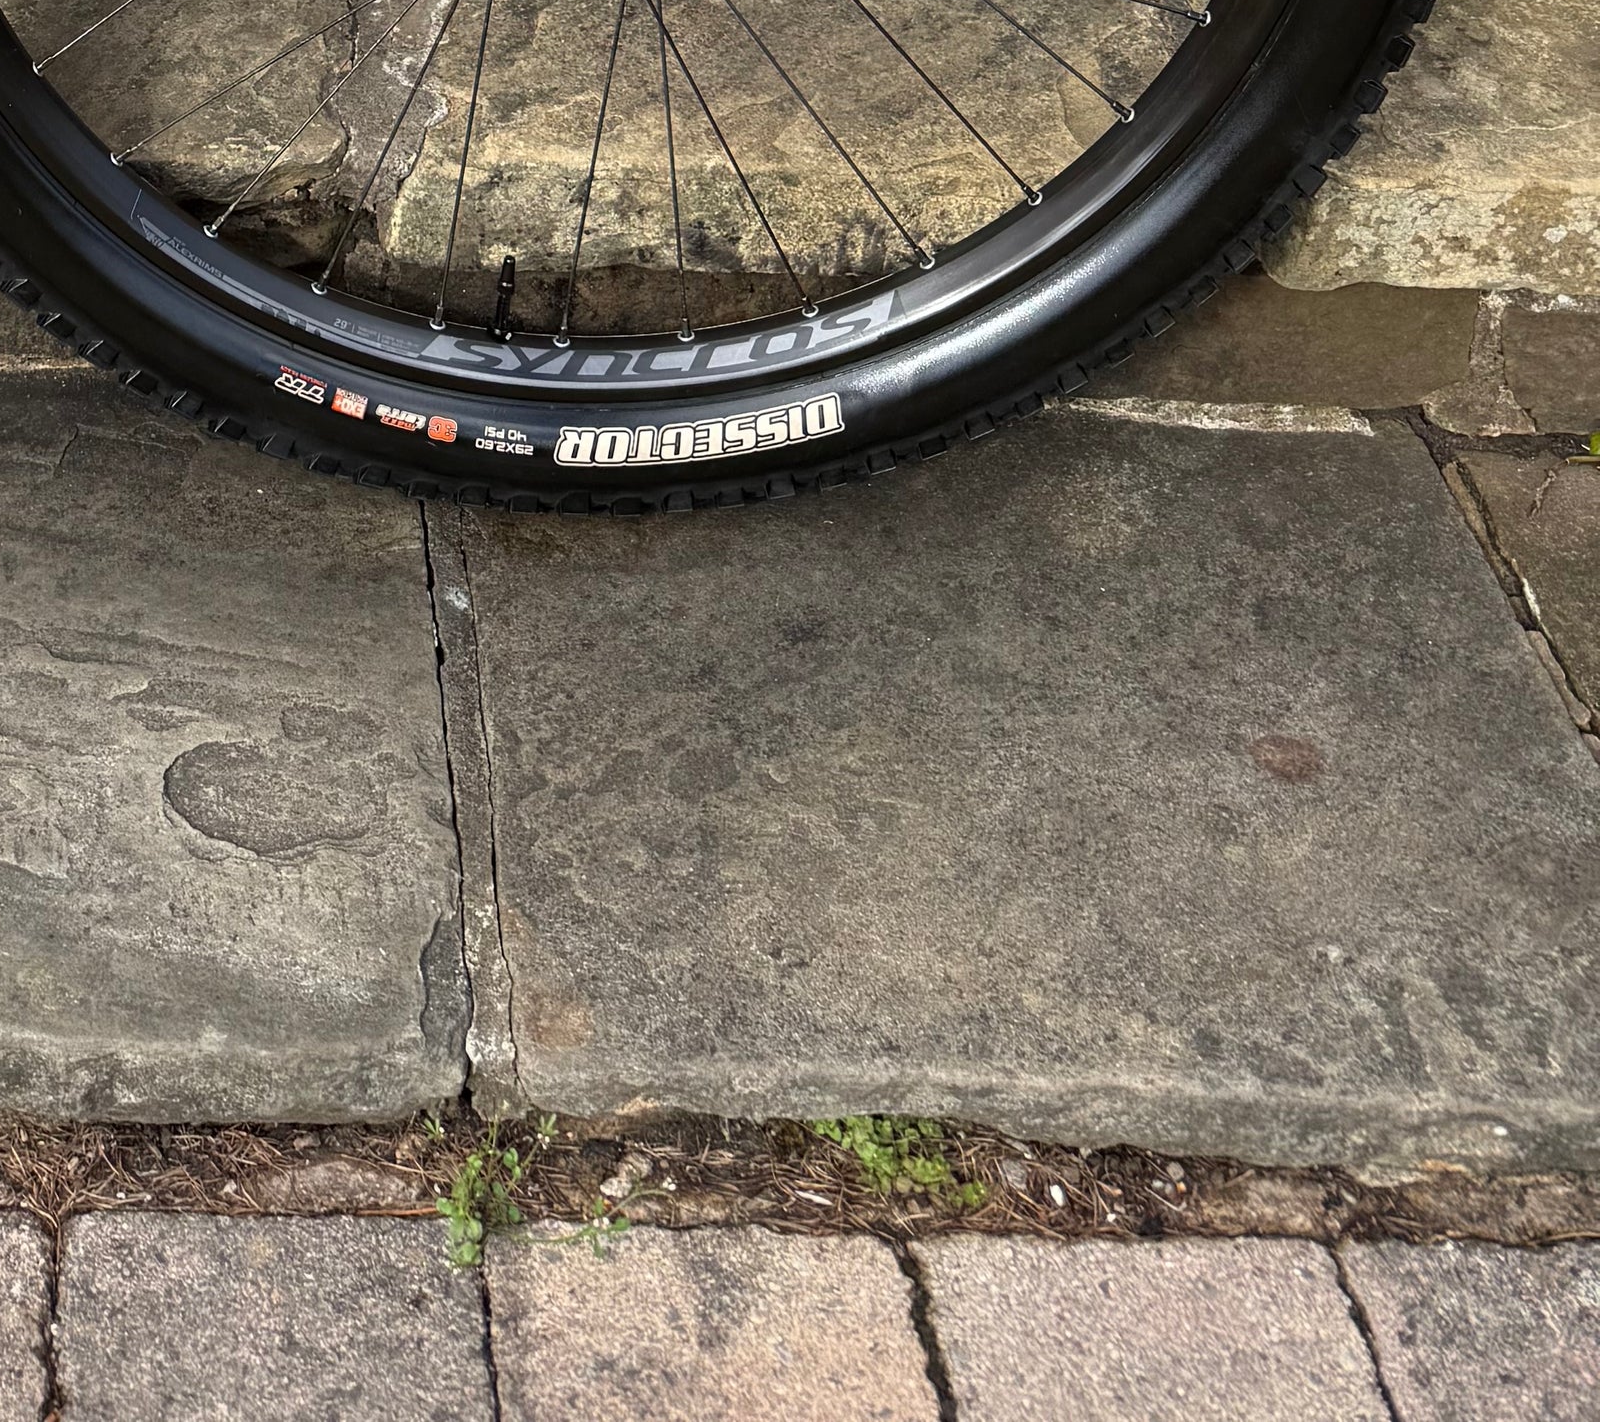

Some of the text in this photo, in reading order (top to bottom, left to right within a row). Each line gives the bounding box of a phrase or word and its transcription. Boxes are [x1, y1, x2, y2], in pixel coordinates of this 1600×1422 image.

[168, 238, 223, 279] ALEXRIMS
[274, 372, 325, 404] TR
[428, 415, 457, 442] 3C
[484, 425, 527, 442] 40 PSI
[554, 392, 845, 466] DISSECTOR
